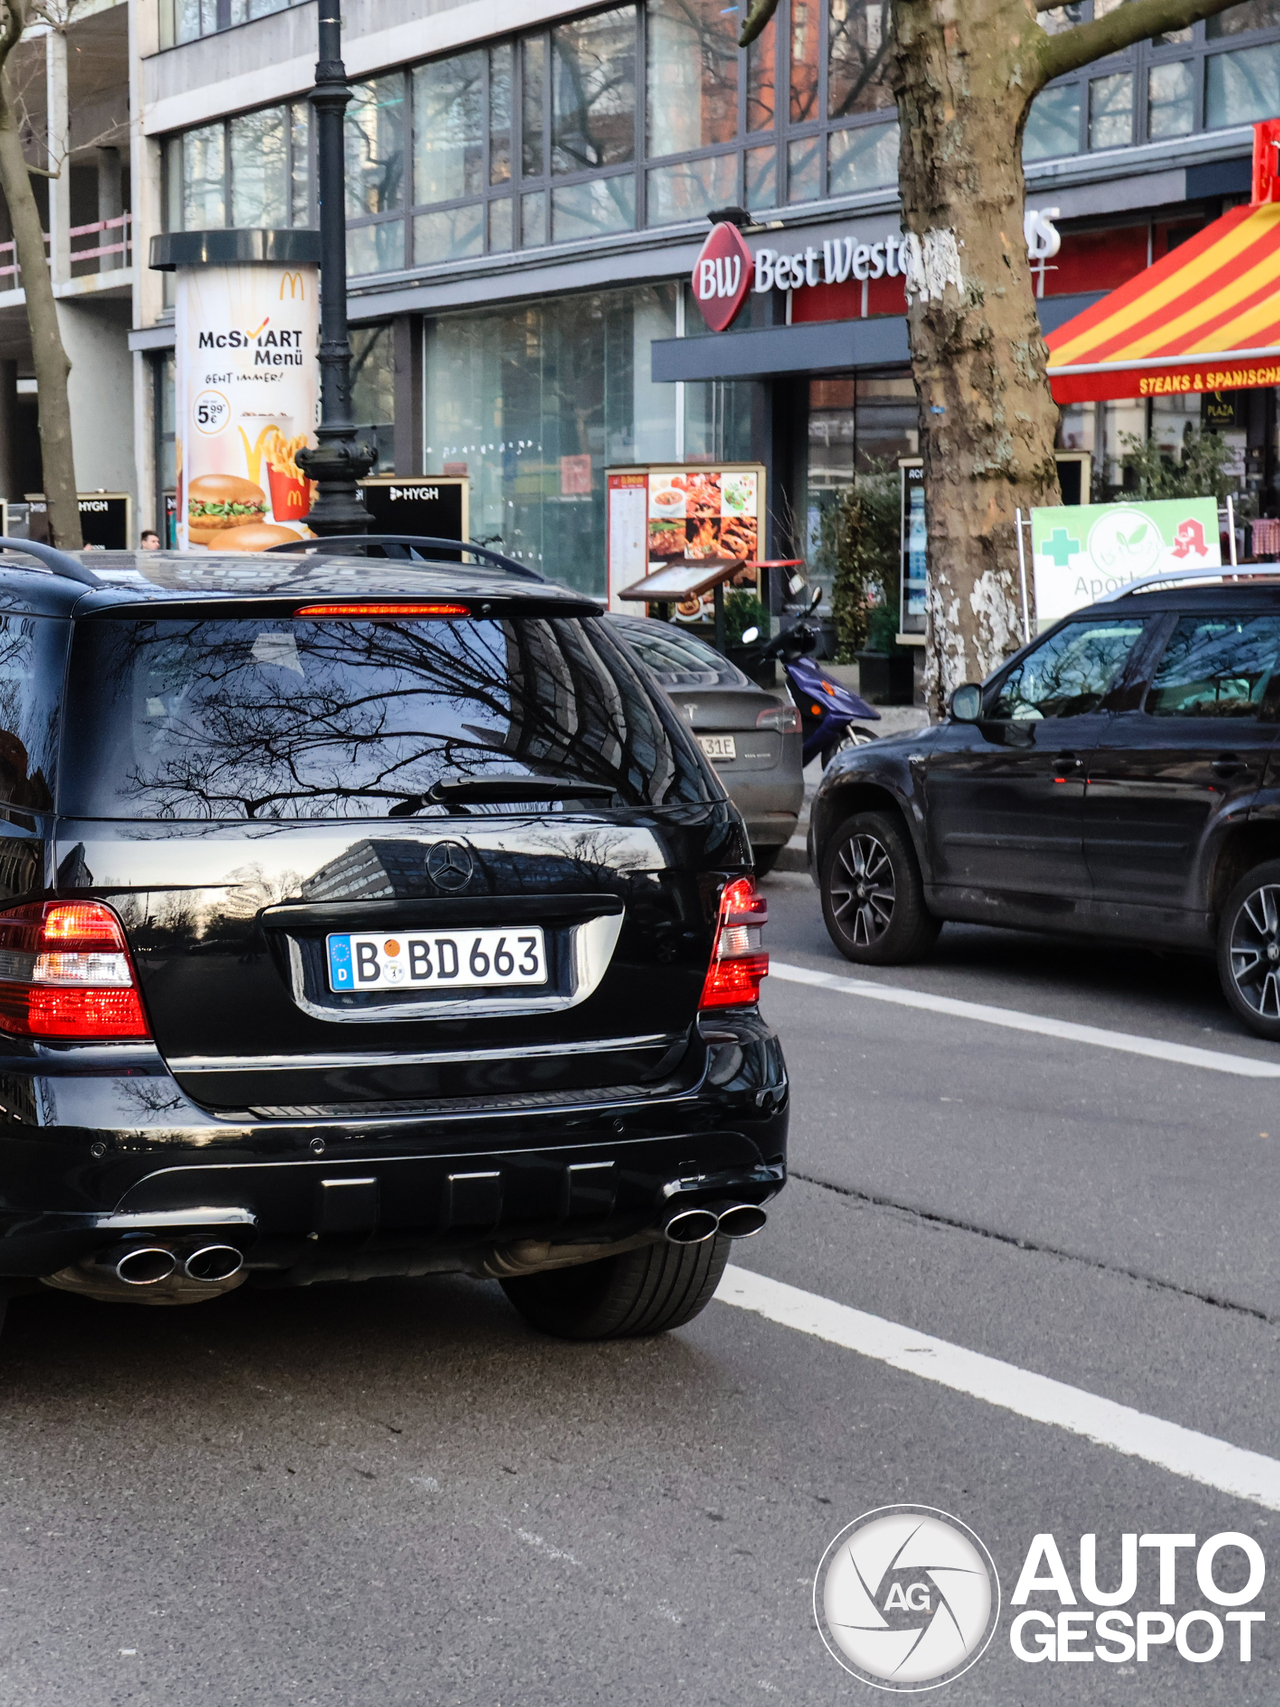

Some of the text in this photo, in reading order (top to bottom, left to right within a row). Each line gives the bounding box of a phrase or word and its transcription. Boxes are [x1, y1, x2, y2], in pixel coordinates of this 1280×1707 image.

[754, 247, 819, 294] Best
[822, 234, 908, 285] West
[699, 254, 741, 301] BW
[198, 328, 303, 349] McSMART
[254, 349, 303, 366] Menü
[205, 372, 284, 384] GEHT IMMER!
[1139, 375, 1191, 395] STEAKS
[1193, 373, 1204, 390] &
[1207, 404, 1234, 416] PLAZA
[403, 487, 439, 500] HYGH
[78, 501, 109, 512] HYGH
[355, 936, 540, 982] B BD 663
[337, 968, 348, 982] D
